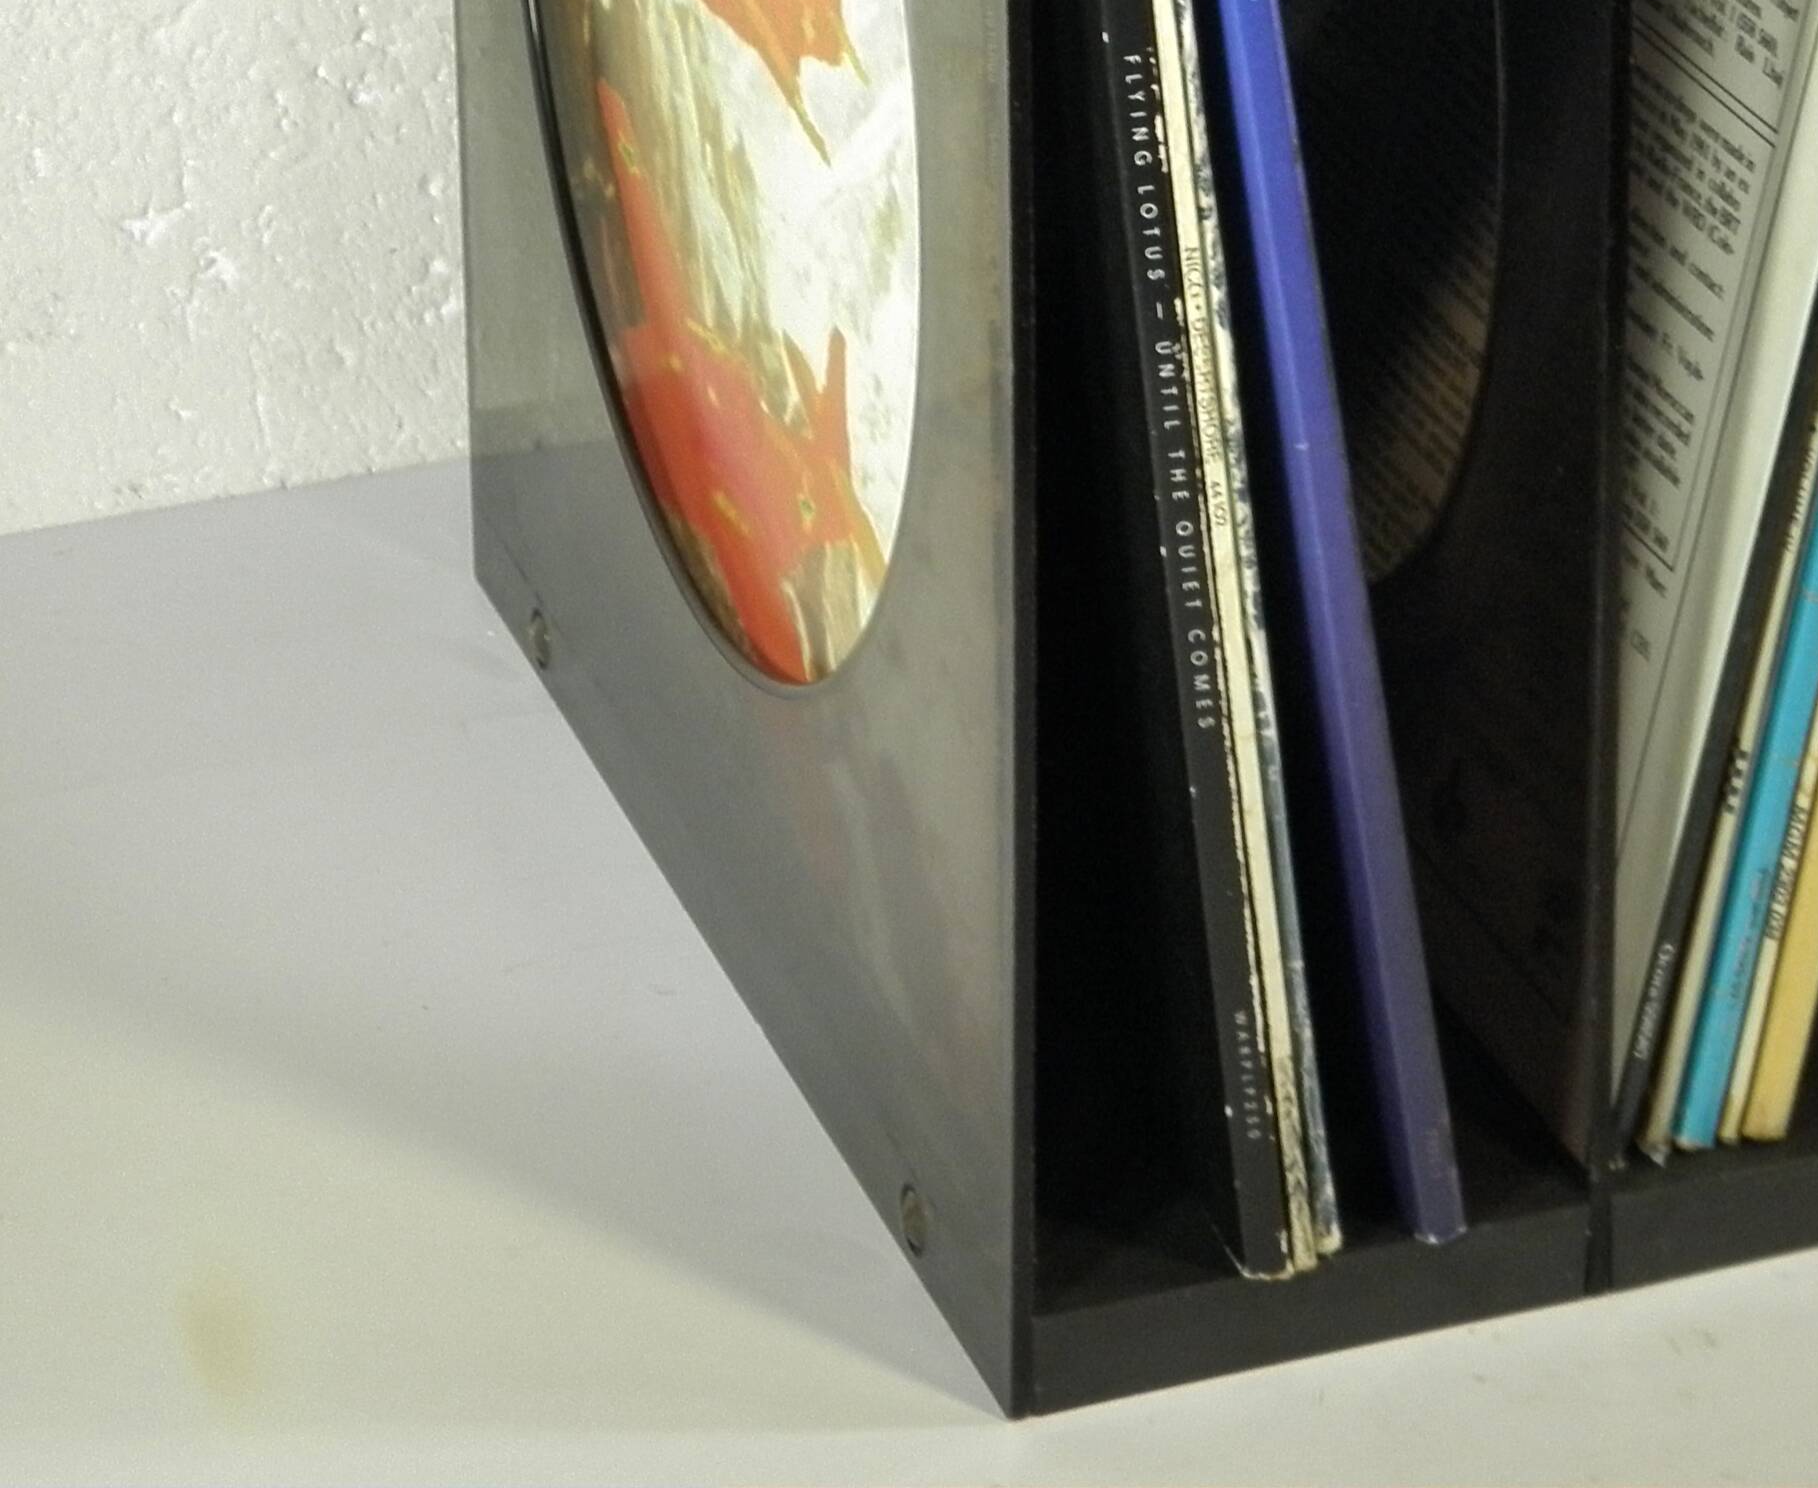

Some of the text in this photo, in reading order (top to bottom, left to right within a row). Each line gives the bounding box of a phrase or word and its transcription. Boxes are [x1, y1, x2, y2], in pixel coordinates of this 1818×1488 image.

[1124, 55, 1153, 167] FLYING
[1138, 185, 1165, 282] LOTUS
[1182, 246, 1207, 298] NICO
[1154, 340, 1175, 432] UNTIL
[1167, 451, 1188, 503] THE
[1175, 520, 1202, 611] QUIET
[1187, 627, 1216, 730] COMES
